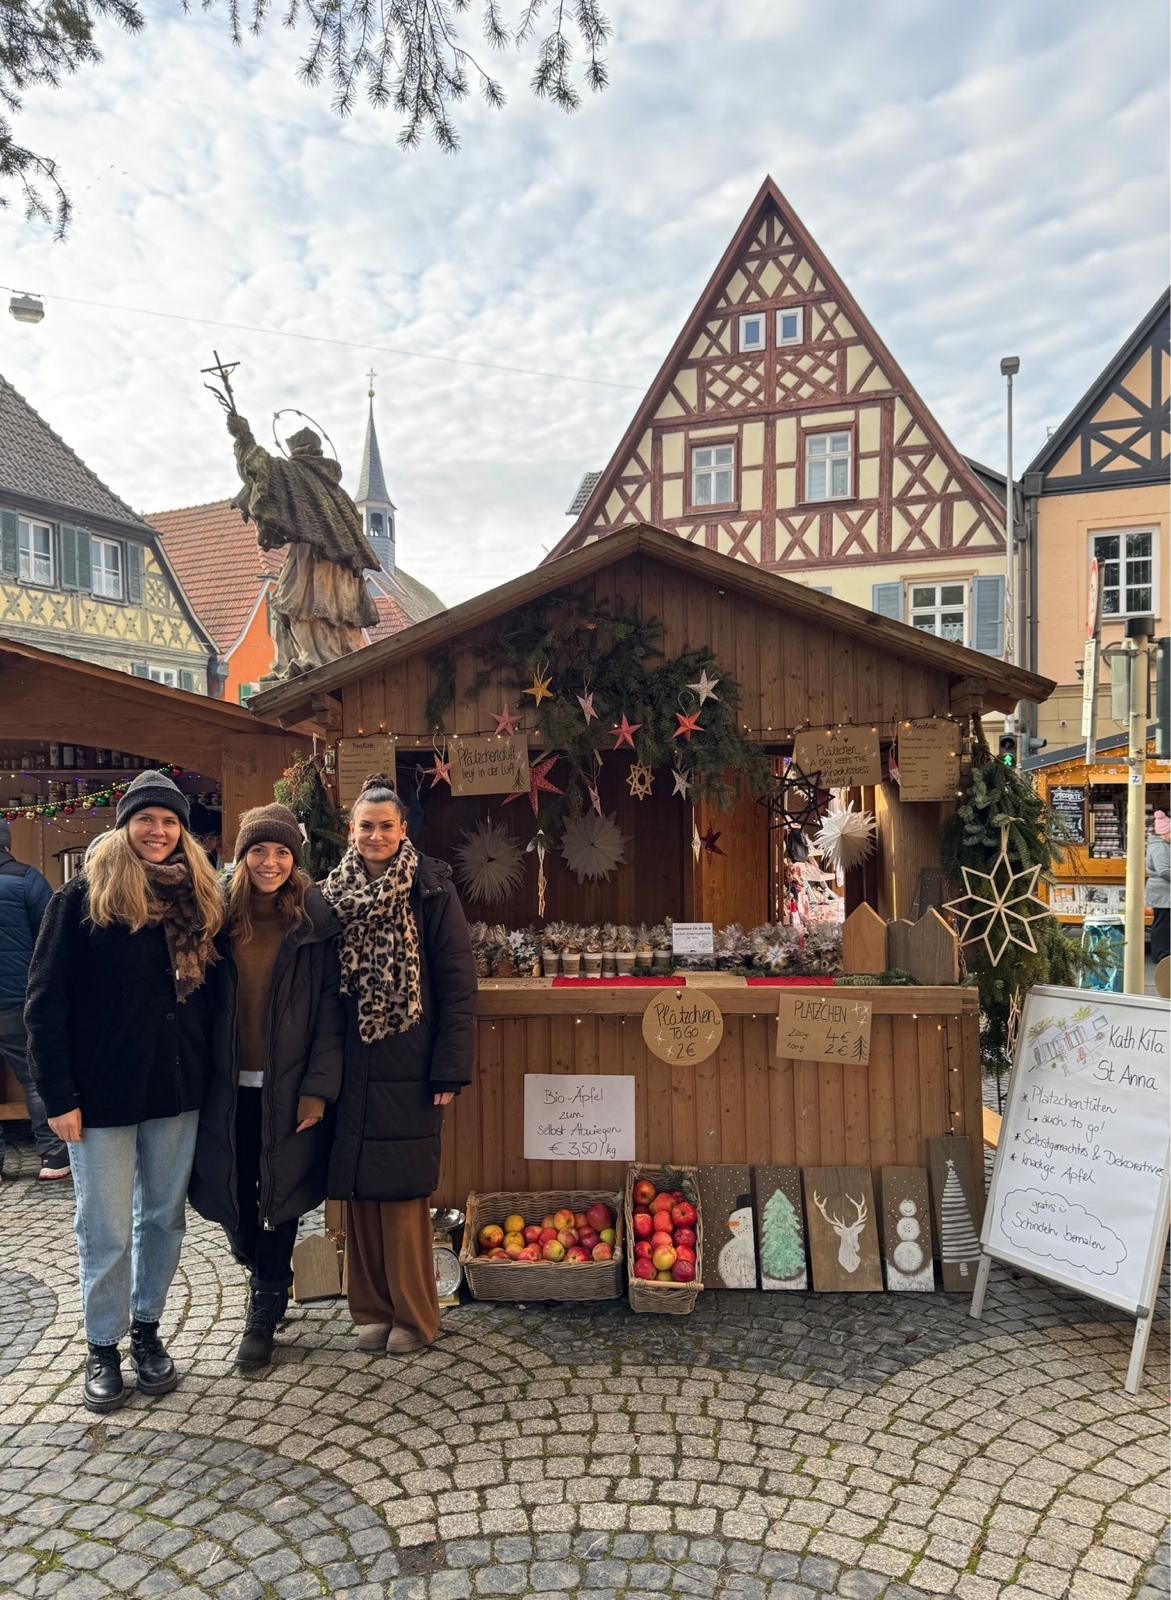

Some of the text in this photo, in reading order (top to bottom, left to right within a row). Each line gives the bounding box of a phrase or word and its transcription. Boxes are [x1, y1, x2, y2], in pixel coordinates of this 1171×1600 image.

[654, 1003, 720, 1027] Plätzchen
[793, 999, 847, 1024] PLÄTZCHEN
[1108, 1024, 1135, 1050] Kath
[1092, 1059, 1158, 1090] St Anna
[558, 1111, 584, 1120] zum
[1041, 1115, 1067, 1128] auch
[1071, 1115, 1083, 1129] to
[536, 1123, 566, 1136] Selbst
[1021, 1128, 1089, 1159] Selbstgemachtes
[1092, 1144, 1101, 1161] &
[1029, 1200, 1056, 1214] gratis
[1011, 1211, 1106, 1251] Schindeln bemalen
